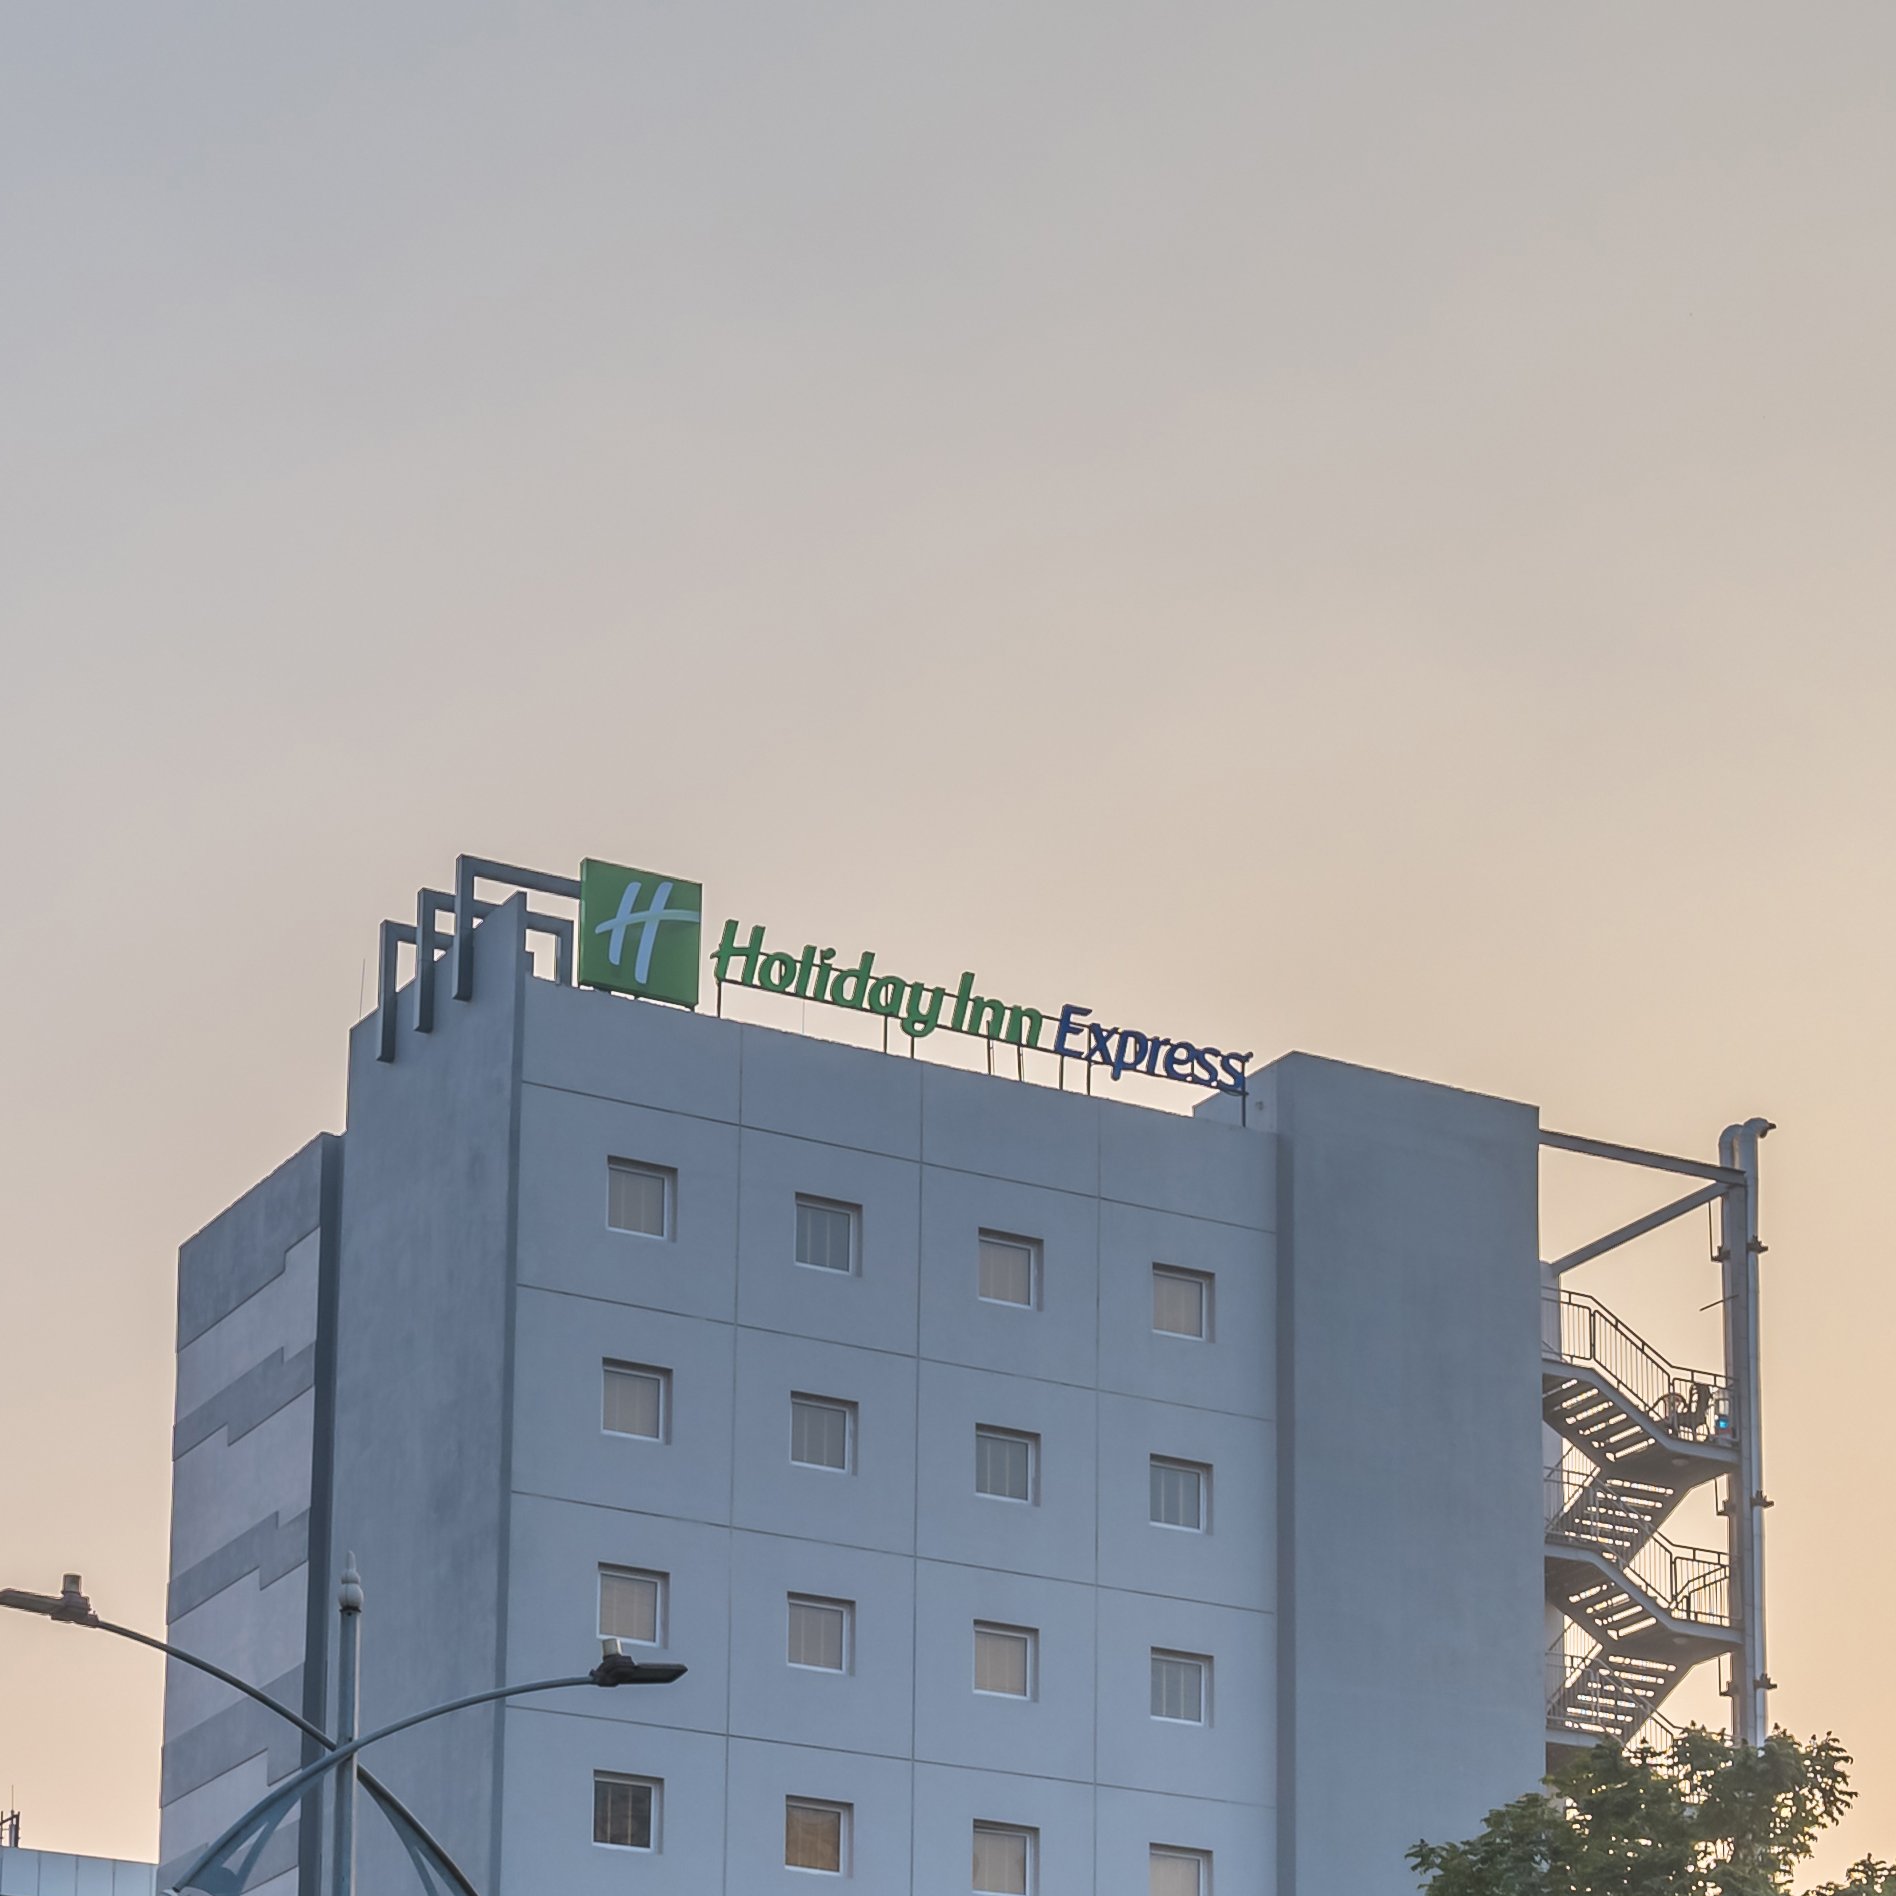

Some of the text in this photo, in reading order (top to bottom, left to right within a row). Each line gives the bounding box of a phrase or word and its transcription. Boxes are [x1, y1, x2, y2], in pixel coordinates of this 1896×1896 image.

[709, 918, 1254, 1091] Holiday Inn Express
